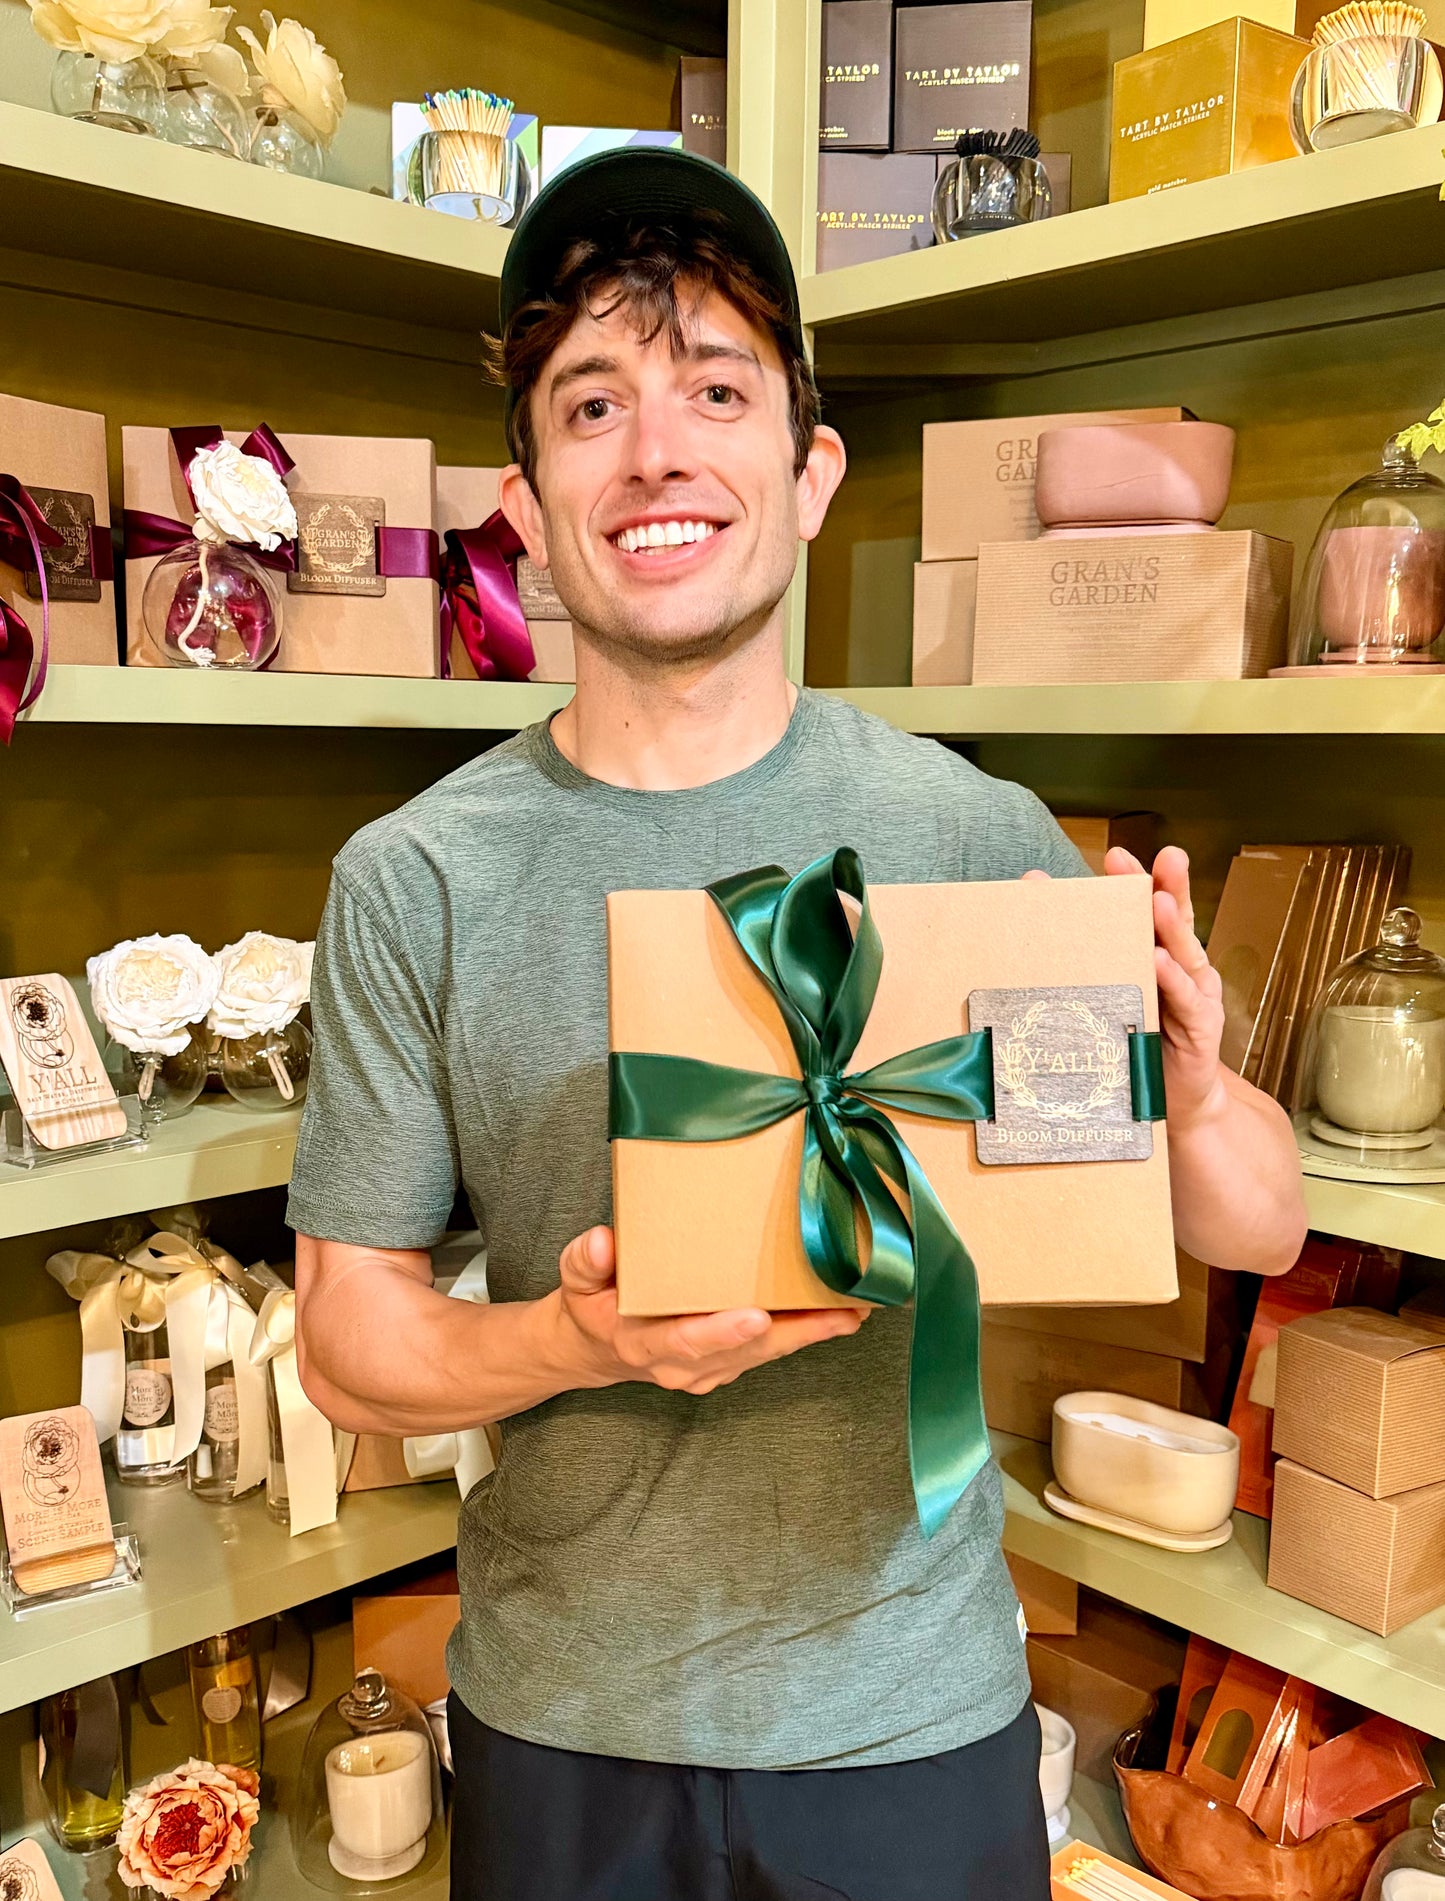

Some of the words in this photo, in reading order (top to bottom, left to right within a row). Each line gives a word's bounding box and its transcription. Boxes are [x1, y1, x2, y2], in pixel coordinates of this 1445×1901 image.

[827, 64, 880, 76] TAYLOR
[905, 70, 937, 81] TART
[943, 68, 961, 79] BY
[966, 64, 1020, 78] TAYLOR
[1120, 120, 1149, 138] TART
[1154, 113, 1170, 126] BY
[1175, 95, 1224, 119] TAYLOR
[1131, 128, 1158, 142] ACRYLIC
[1159, 120, 1182, 133] MATCH
[1183, 111, 1210, 125] STRIKER
[851, 212, 867, 222] BY
[874, 213, 924, 224] TAYLOR
[318, 529, 356, 539] GRAN'S
[316, 539, 359, 548] GARDEN
[300, 573, 331, 583] BLOOM
[334, 574, 377, 585] DIFFUSER
[1050, 556, 1160, 584] GRAN'S
[1050, 583, 1159, 606] GARDEN
[1023, 1048, 1100, 1073] Y'ALL
[28, 1066, 97, 1093] Y'ALL
[997, 1127, 1052, 1144] BLOOM
[1057, 1128, 1133, 1143] DIFFUSER
[15, 1509, 50, 1525] MORE
[67, 1498, 102, 1512] MORE
[59, 1522, 104, 1540] SAMPLE
